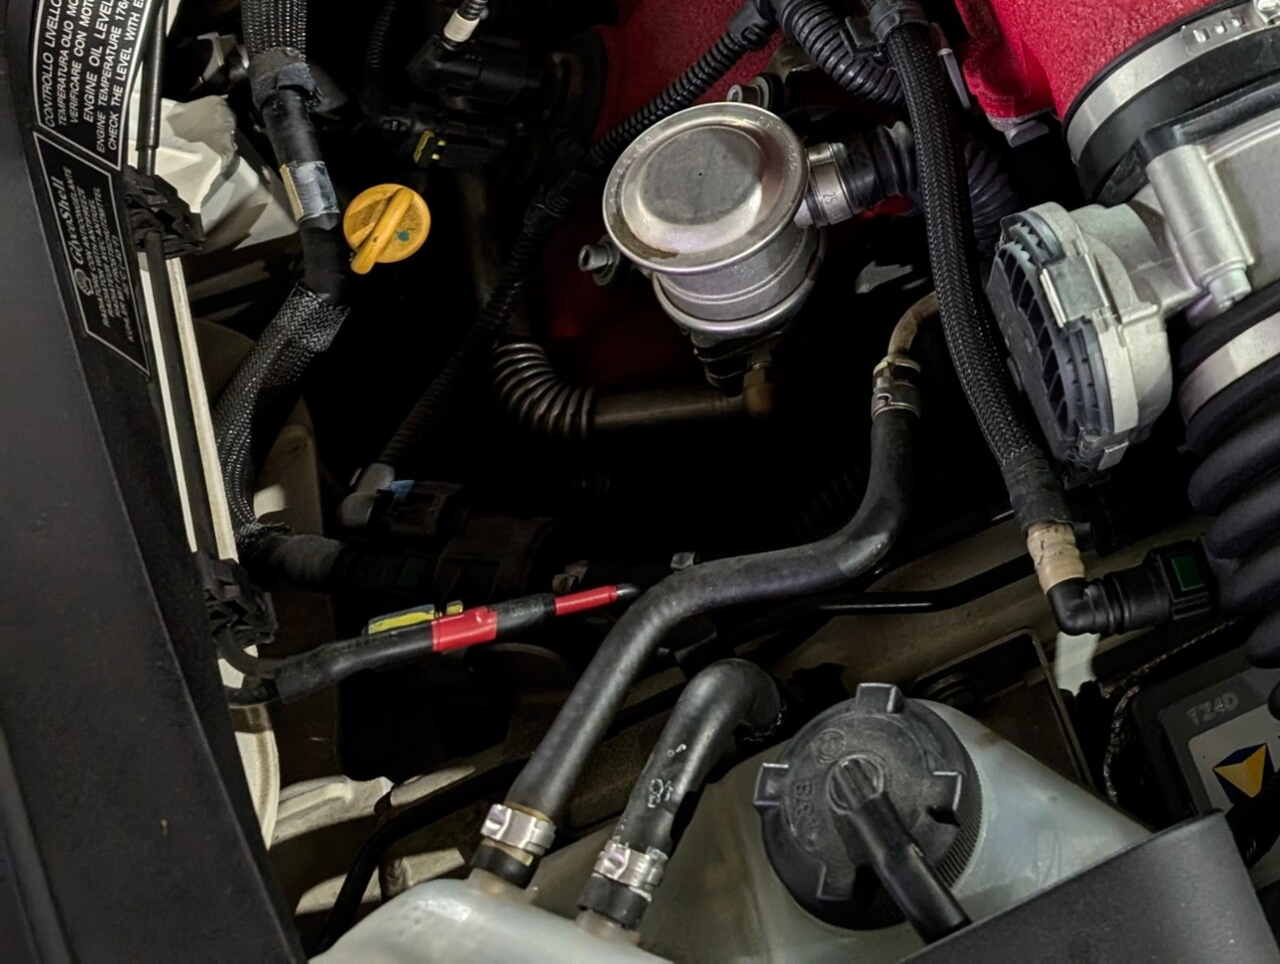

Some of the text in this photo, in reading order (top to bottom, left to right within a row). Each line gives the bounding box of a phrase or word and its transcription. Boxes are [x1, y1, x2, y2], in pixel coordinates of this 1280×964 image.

[60, 20, 74, 48] OLIO
[73, 30, 87, 57] CON
[124, 12, 140, 41] WITH
[88, 46, 102, 67] OIL
[97, 26, 123, 106] TEMPERATURE
[116, 46, 132, 82] LEVEL
[42, 52, 55, 127] CONTROLLO
[56, 49, 70, 126] TEMPERATURA
[69, 60, 82, 124] VERIFICARE
[83, 71, 98, 123] ENGINE
[111, 84, 123, 108] THE
[95, 111, 107, 153] ENGINE
[108, 111, 119, 151] CHECK
